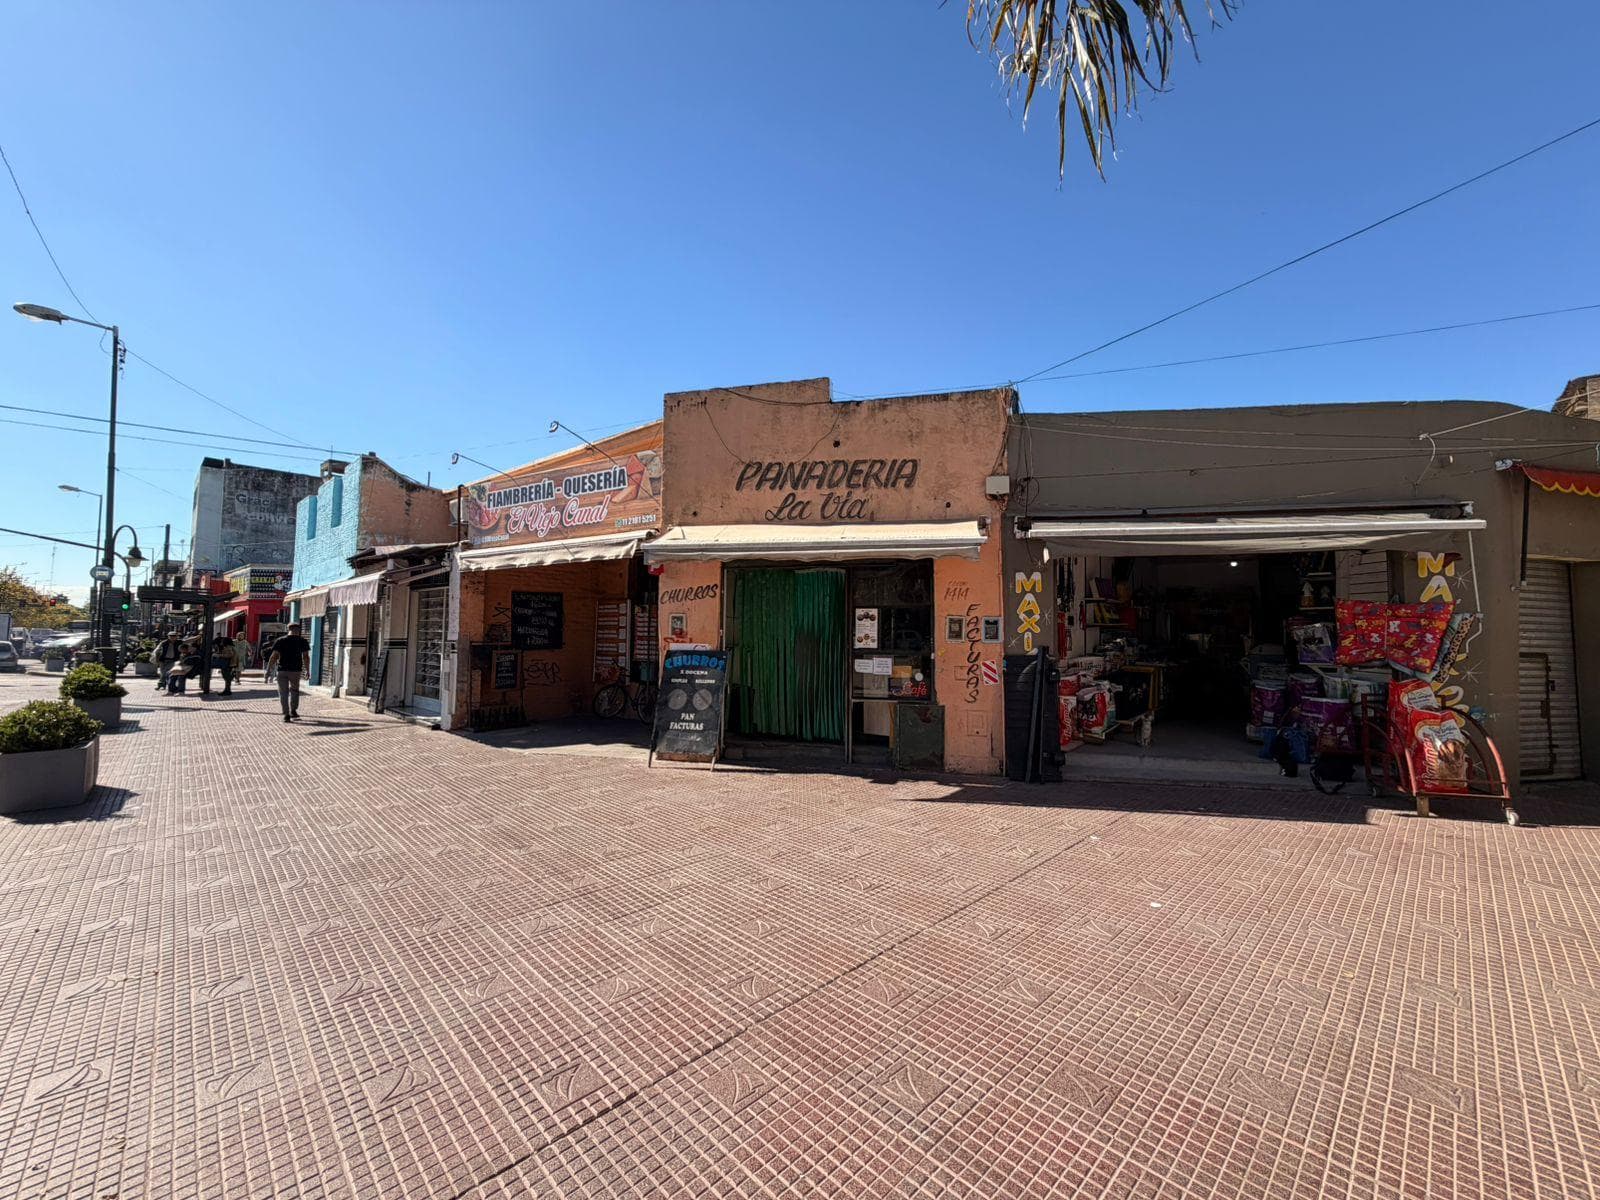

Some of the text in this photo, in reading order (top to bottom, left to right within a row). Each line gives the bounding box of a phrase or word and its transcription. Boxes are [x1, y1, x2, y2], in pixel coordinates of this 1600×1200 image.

[486, 479, 555, 509] FIAMBRERÍA
[564, 466, 628, 498] QUESERÍA
[735, 459, 918, 491] PANADERIA
[563, 495, 610, 527] Canal
[765, 493, 811, 521] La
[660, 583, 719, 604] CHURROS
[665, 654, 725, 672] CHURROS
[964, 603, 982, 703] FACTURAS
[669, 721, 705, 731] FACTURAS
[680, 712, 697, 721] PAN
